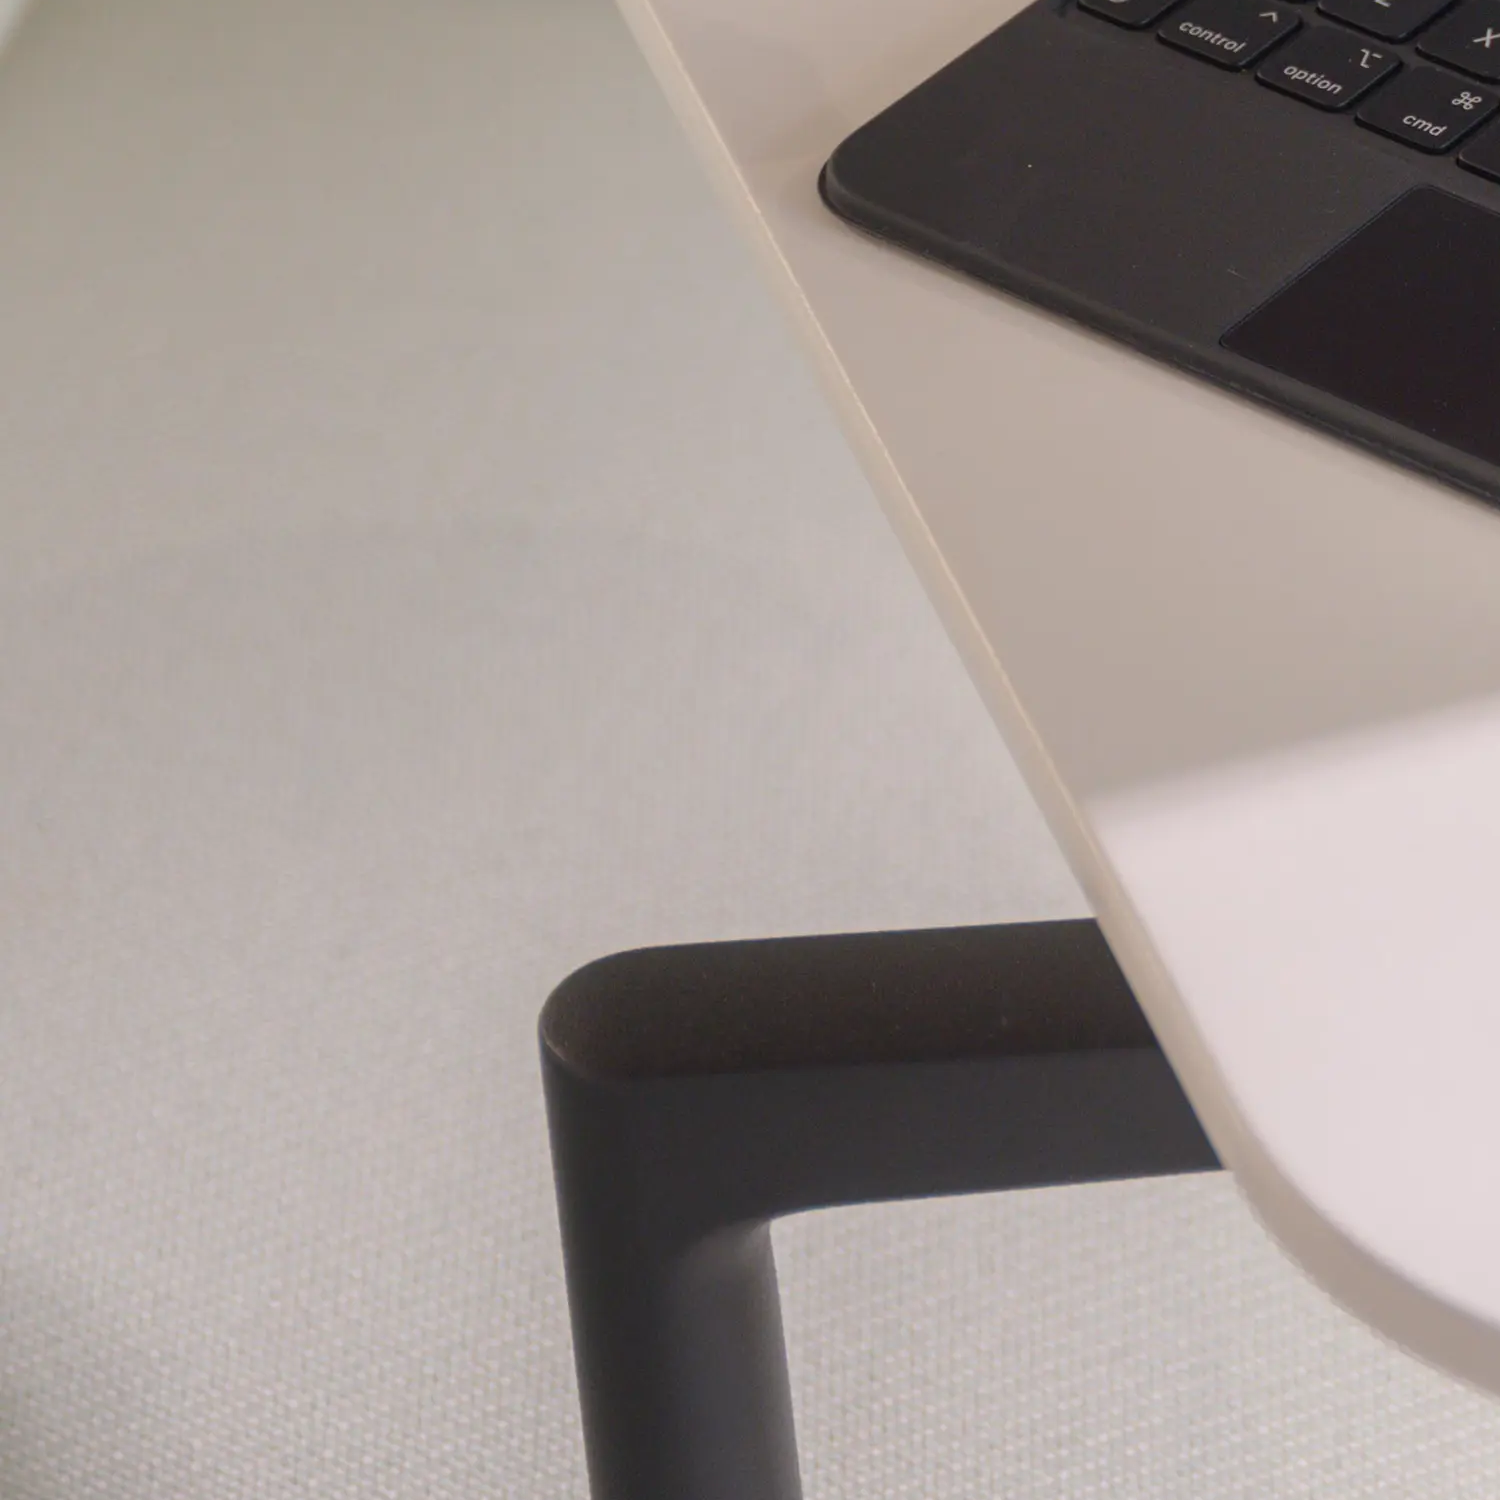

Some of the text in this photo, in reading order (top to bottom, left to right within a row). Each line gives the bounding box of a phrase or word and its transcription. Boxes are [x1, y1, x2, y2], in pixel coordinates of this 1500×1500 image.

[1178, 21, 1449, 138] control option cmd
